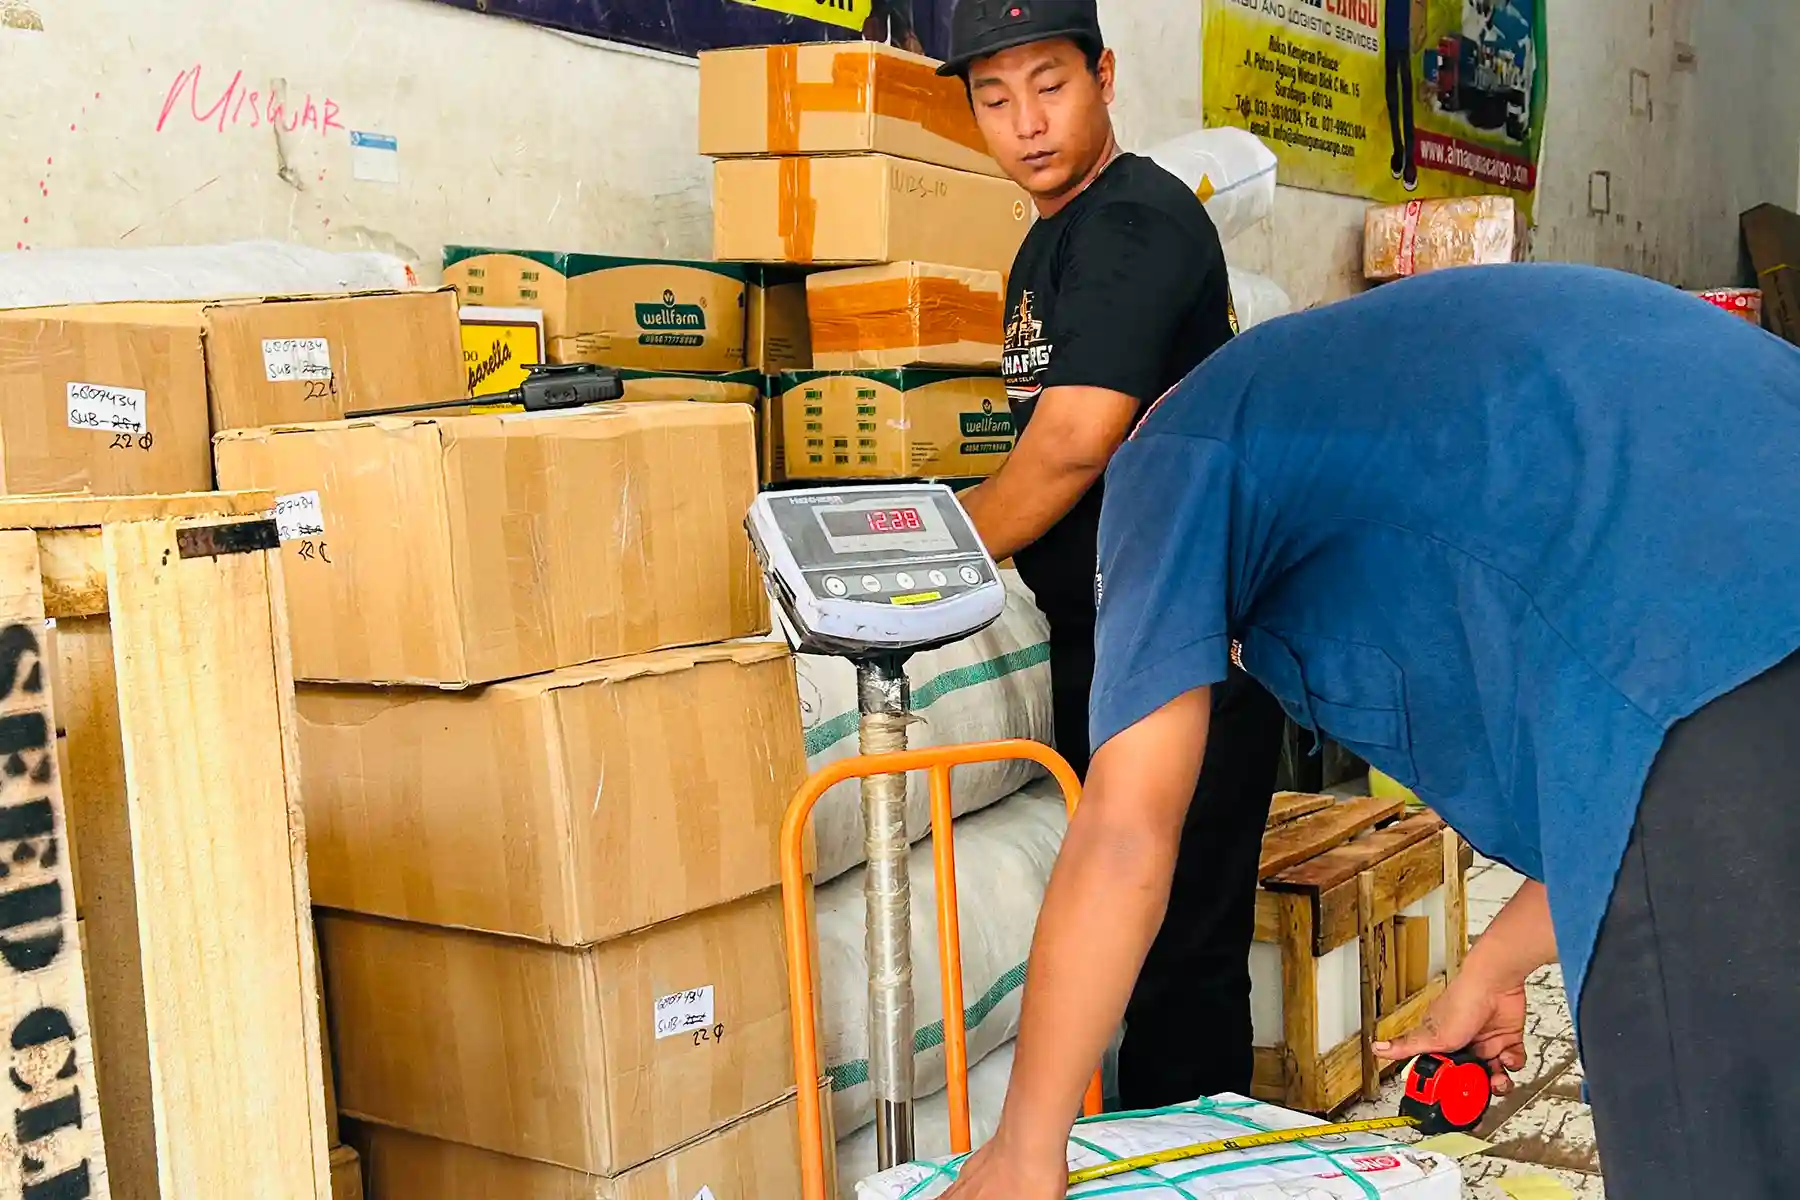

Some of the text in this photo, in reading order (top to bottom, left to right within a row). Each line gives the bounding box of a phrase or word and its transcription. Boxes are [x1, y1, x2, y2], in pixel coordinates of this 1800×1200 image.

[1335, 25, 1378, 52] SERVICES
[643, 308, 699, 325] wellfarm
[966, 417, 1011, 433] wellfarm
